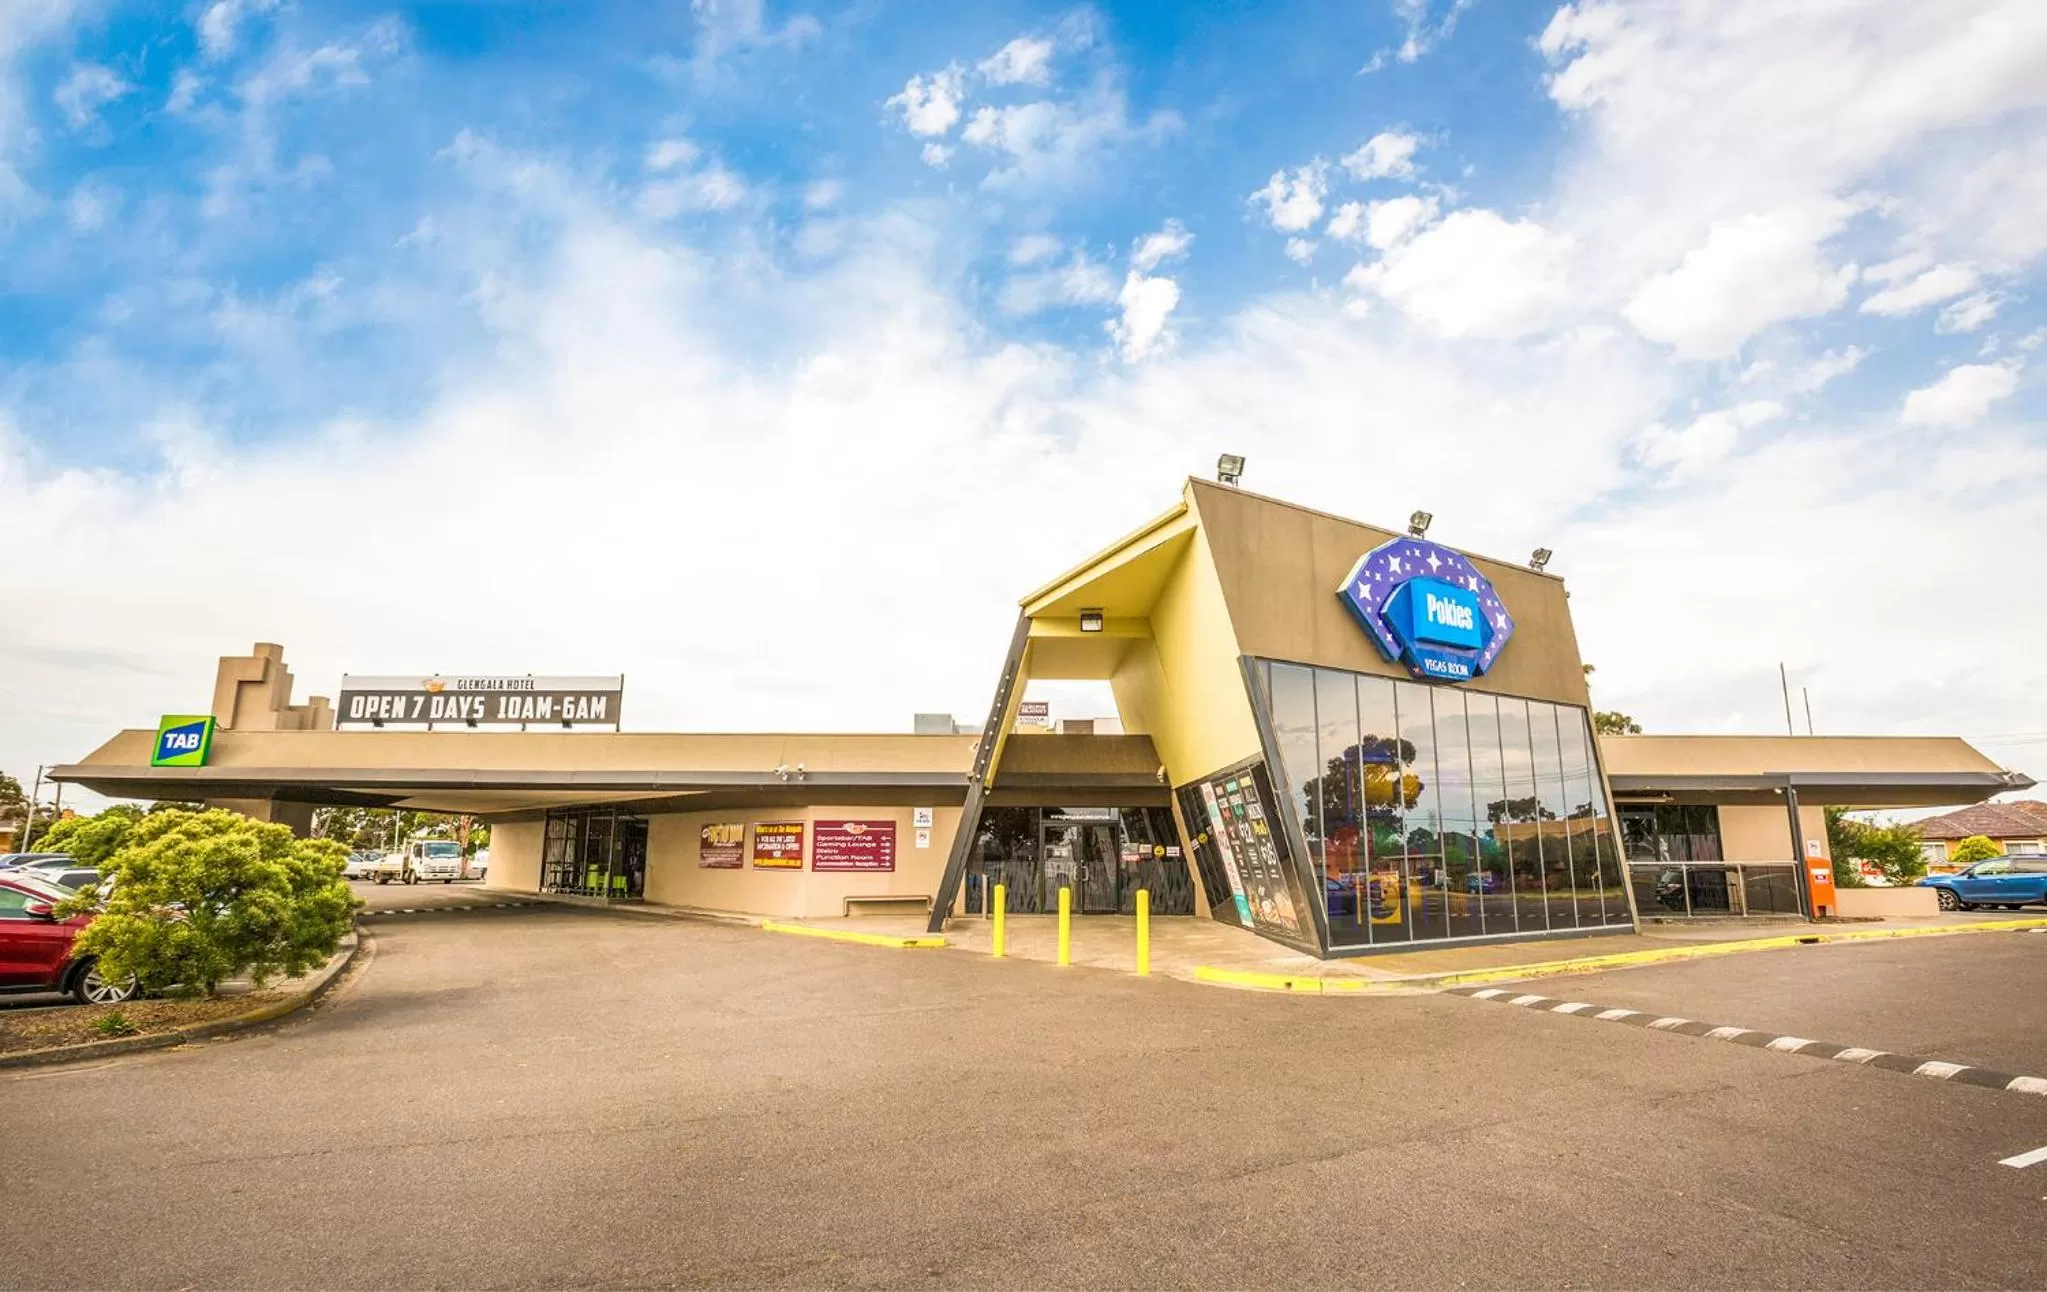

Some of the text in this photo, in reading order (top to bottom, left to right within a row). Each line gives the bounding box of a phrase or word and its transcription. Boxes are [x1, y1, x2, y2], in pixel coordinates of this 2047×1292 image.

[1426, 593, 1473, 630] Pokies
[1424, 658, 1469, 676] VEGAS ROOM
[458, 679, 535, 690] GLENGALA HOTEL
[350, 696, 607, 720] OPEN 7 DAYS 10AM-6AM
[165, 733, 200, 749] TAB
